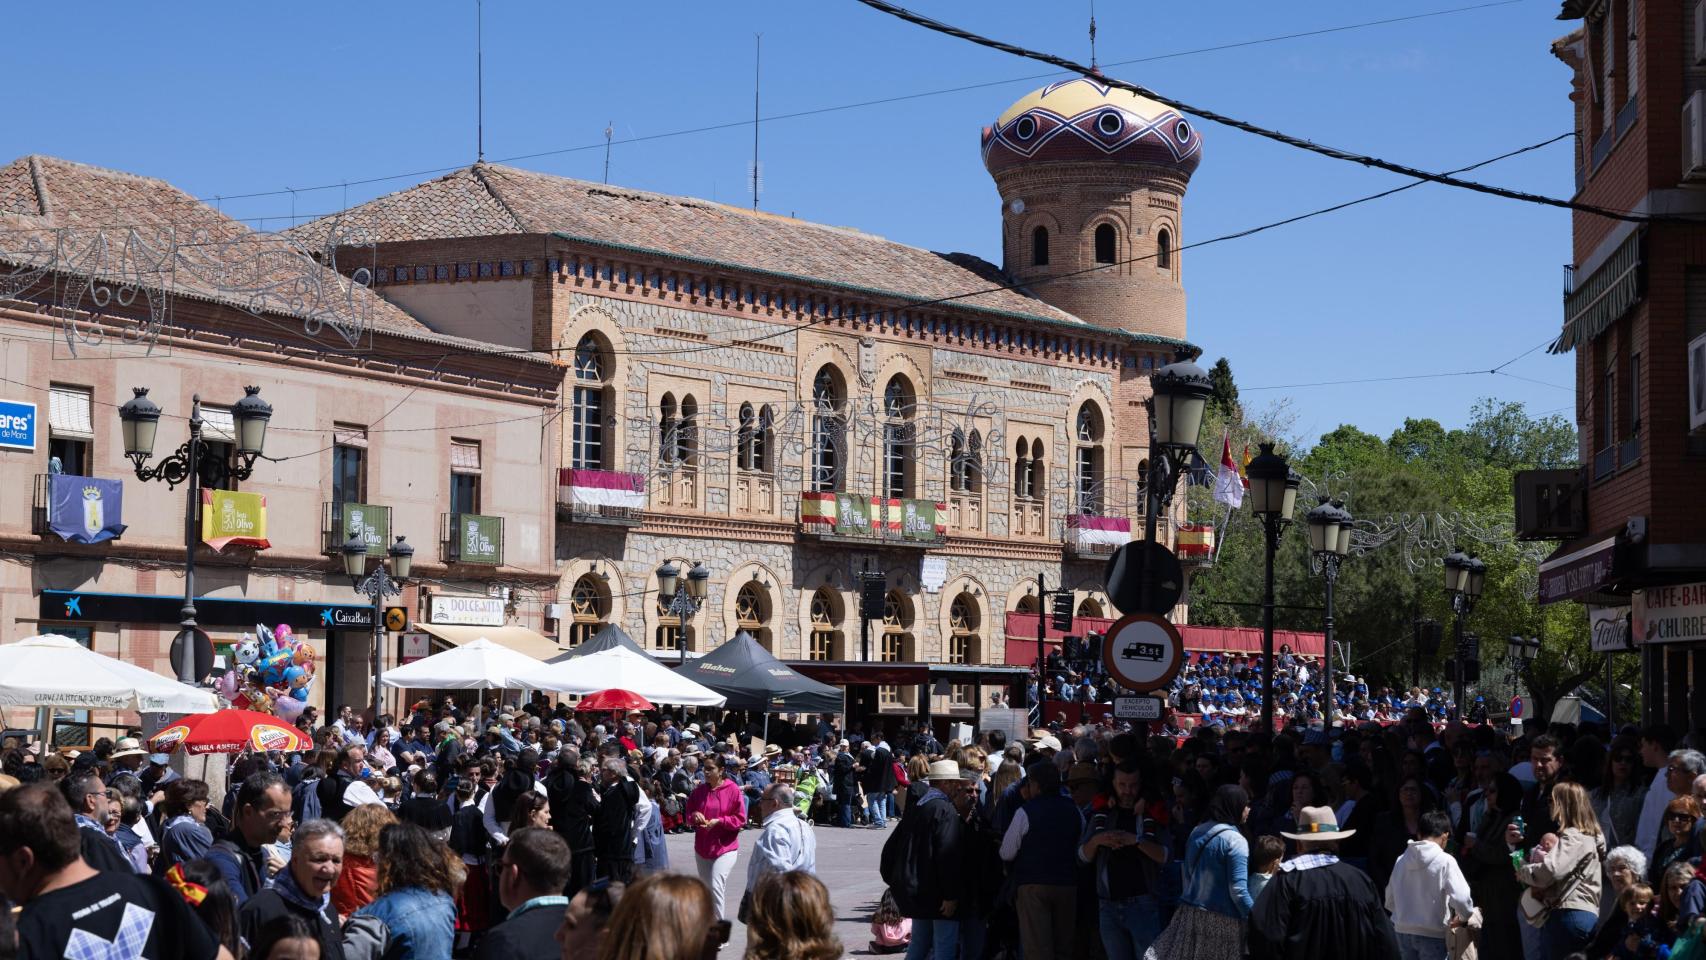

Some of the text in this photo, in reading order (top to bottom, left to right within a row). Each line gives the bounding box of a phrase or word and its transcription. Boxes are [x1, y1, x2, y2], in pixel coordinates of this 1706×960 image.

[1, 430, 27, 440] de Mora
[236, 519, 254, 530] Olivo
[365, 531, 381, 543] Olivo
[480, 541, 495, 552] Olivo
[451, 599, 502, 613] DOLCE VITA
[335, 609, 372, 624] CaixaBank
[1658, 616, 1706, 639] CHURRE
[700, 663, 736, 673] Mahou
